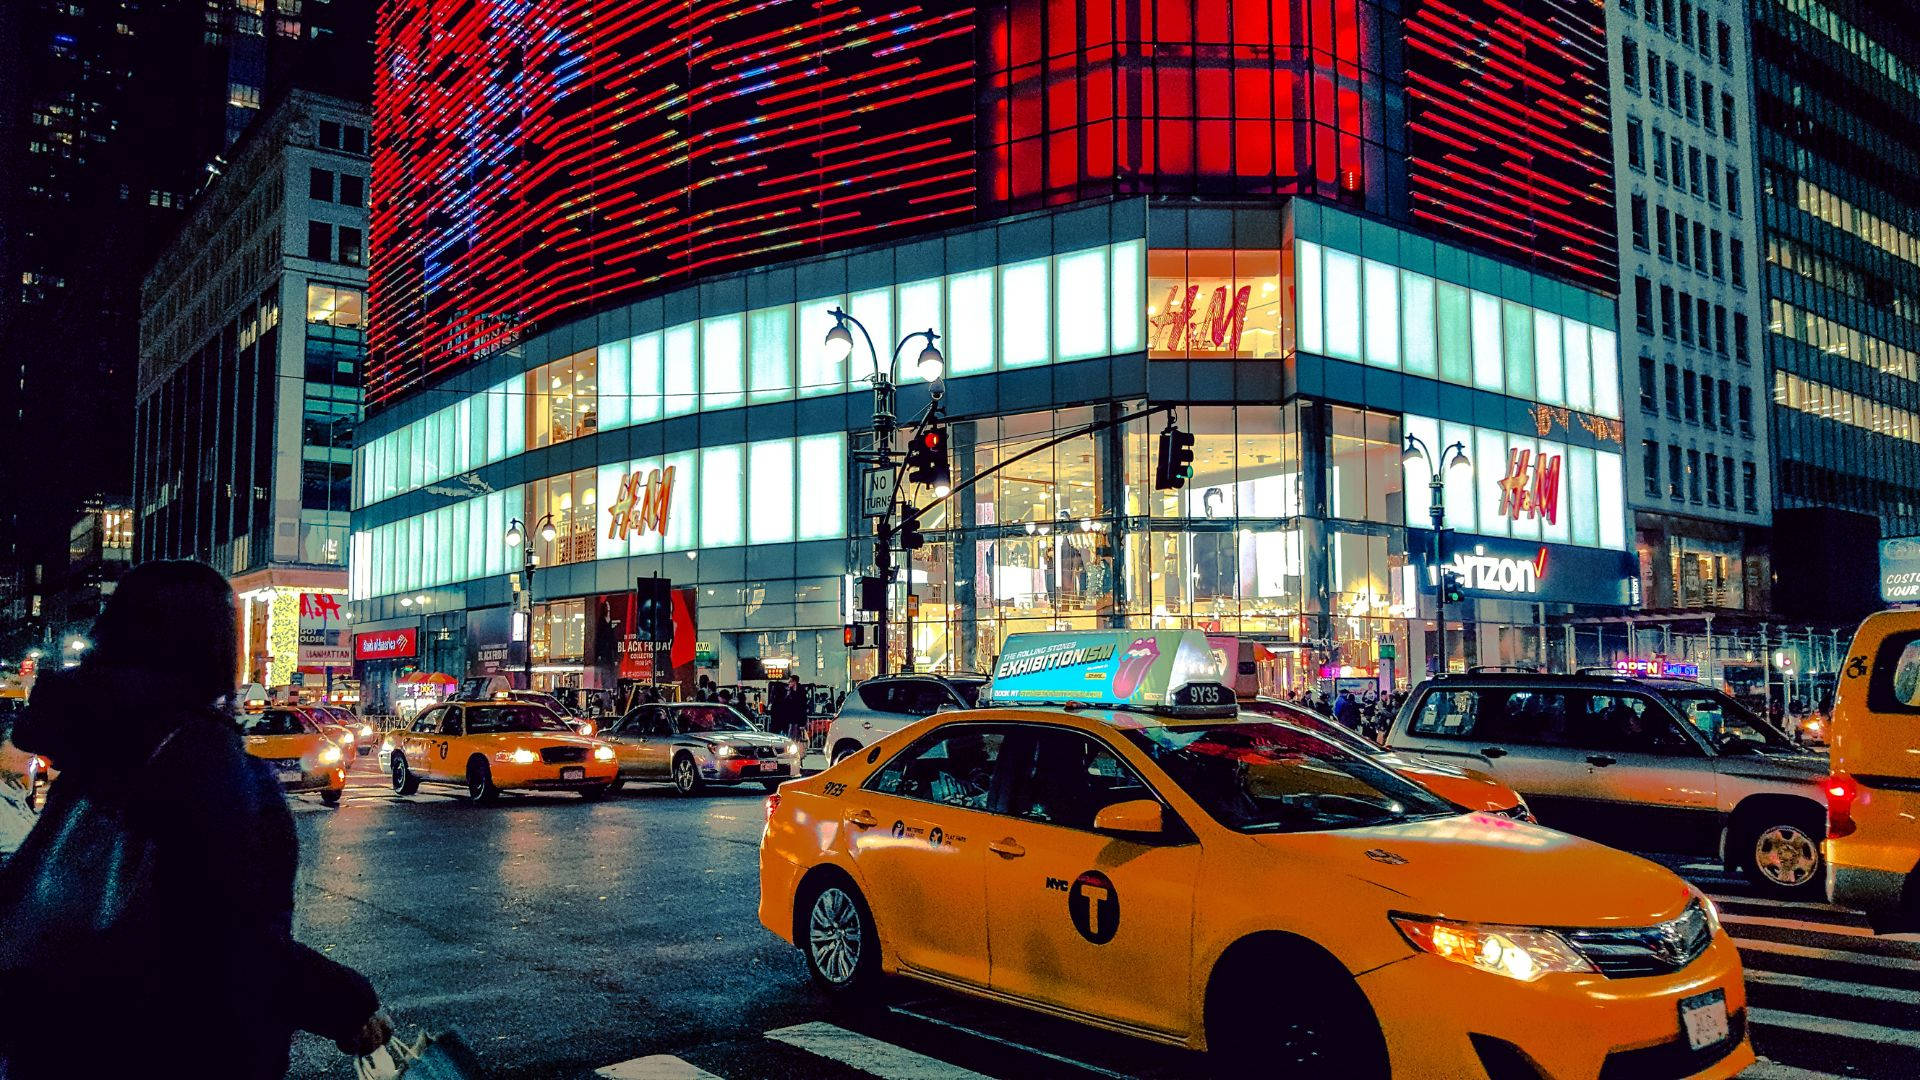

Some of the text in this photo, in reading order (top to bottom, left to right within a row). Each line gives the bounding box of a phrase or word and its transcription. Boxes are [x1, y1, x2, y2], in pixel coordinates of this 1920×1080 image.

[1149, 284, 1252, 351] H&M
[871, 476, 886, 490] NO
[1498, 447, 1561, 526] H&M
[608, 466, 676, 540] H&M
[1887, 585, 1920, 597] YOUR
[617, 641, 643, 653] BLACK
[1003, 641, 1077, 661] THE ROLLING STONES
[997, 643, 1116, 679] EXHIBITIONISM
[1617, 661, 1658, 674] OPEN
[1191, 686, 1219, 703] 9Y35
[823, 781, 848, 797] 9Y35
[1046, 876, 1108, 934] NYC T
